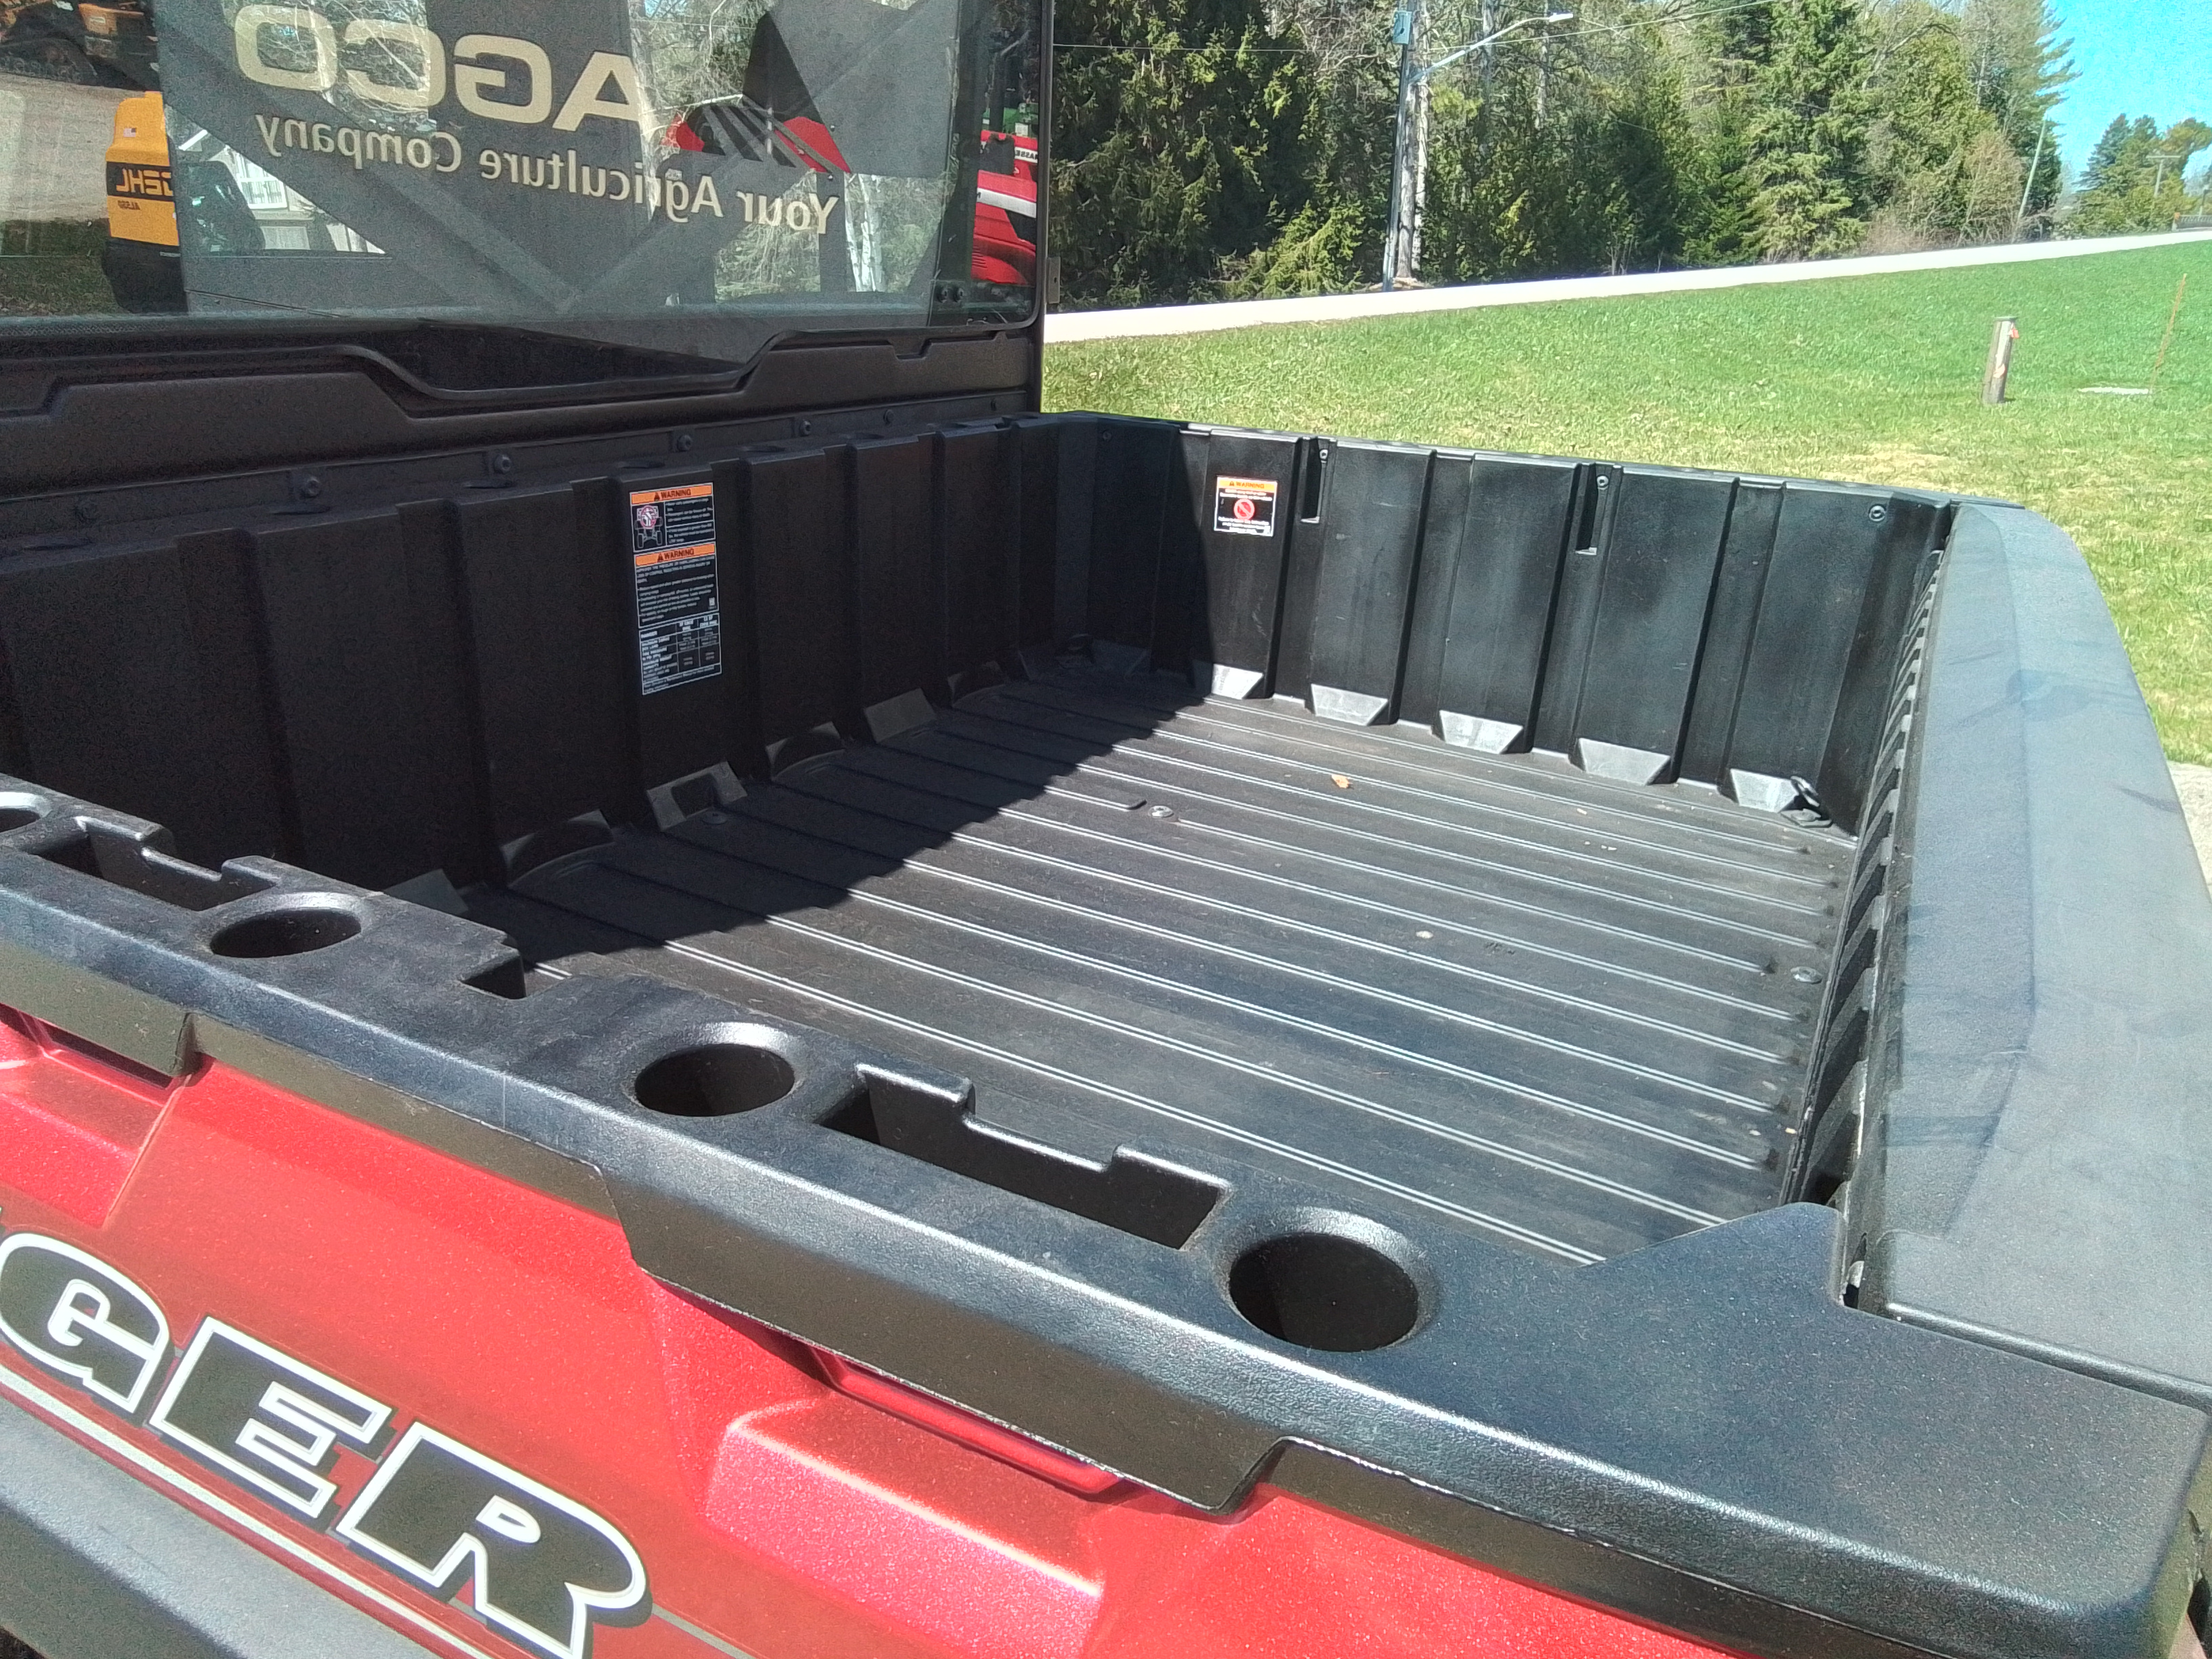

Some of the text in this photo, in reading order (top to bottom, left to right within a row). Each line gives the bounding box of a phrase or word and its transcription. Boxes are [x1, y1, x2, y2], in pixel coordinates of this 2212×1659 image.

[661, 489, 691, 499] WARNING
[664, 548, 695, 559] WARNING
[0, 1231, 651, 1659] GER
